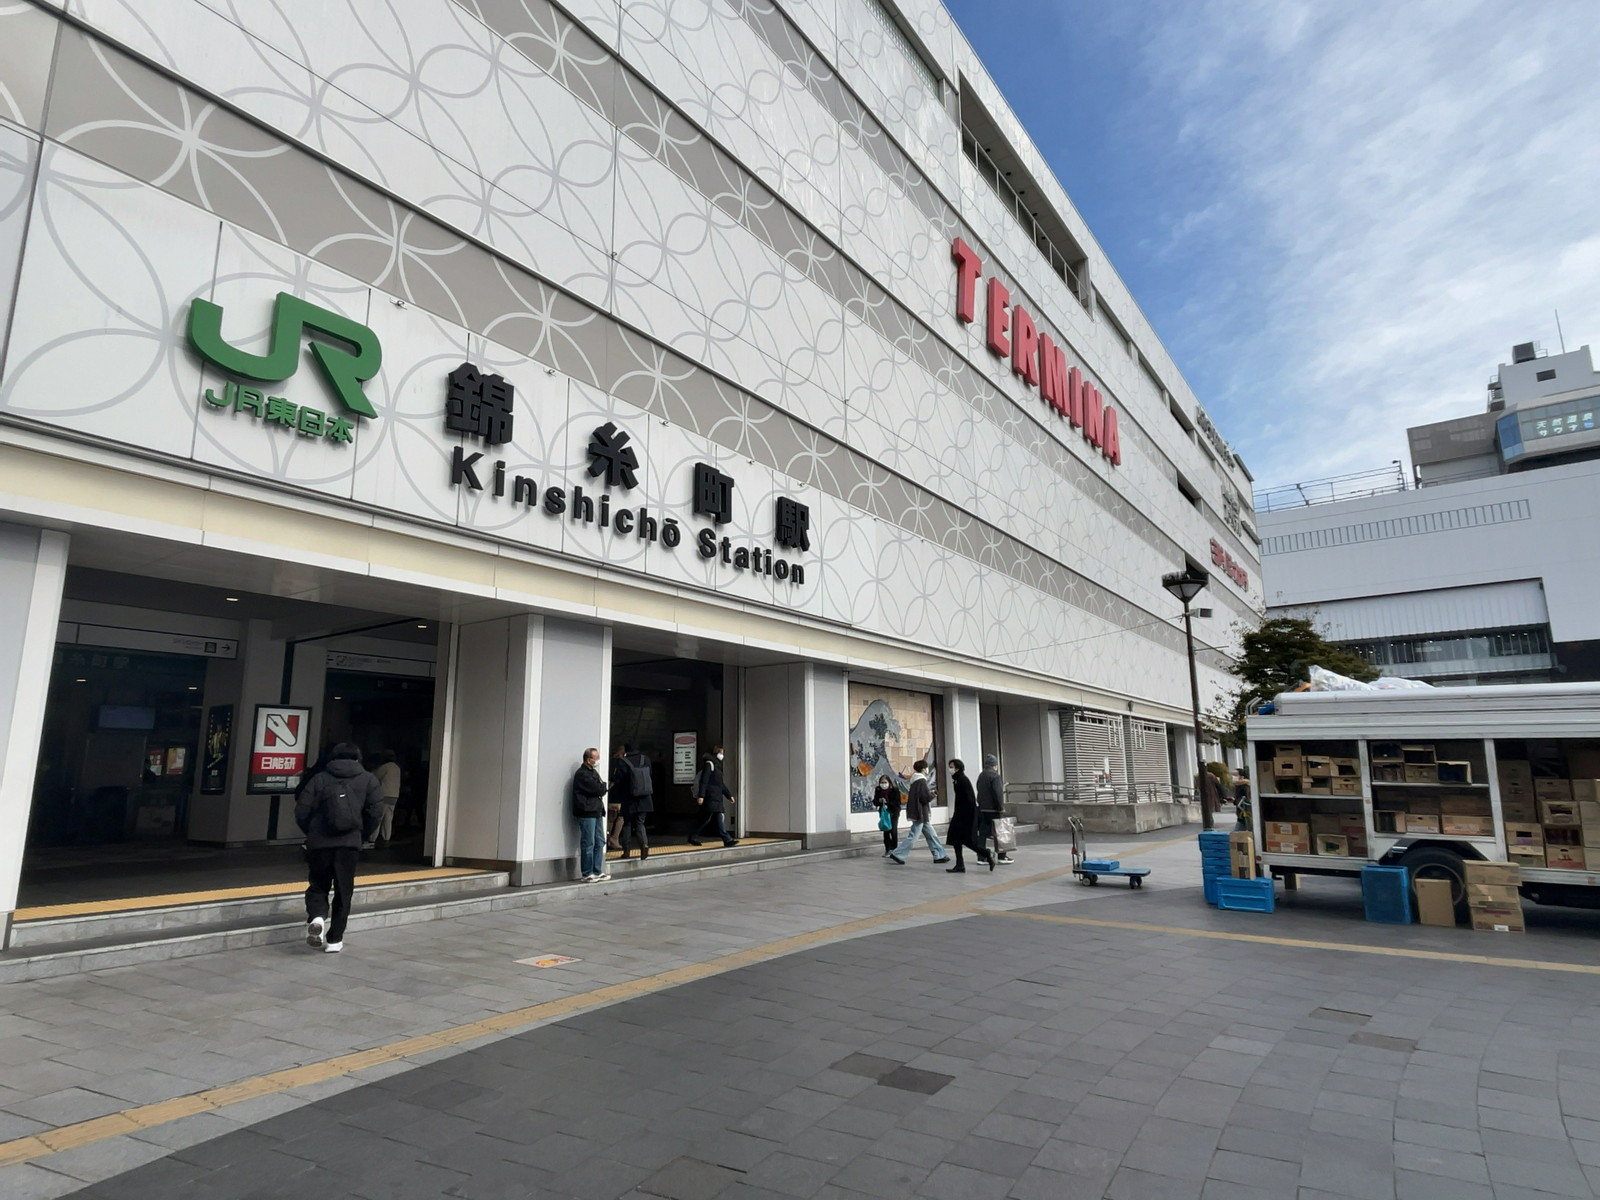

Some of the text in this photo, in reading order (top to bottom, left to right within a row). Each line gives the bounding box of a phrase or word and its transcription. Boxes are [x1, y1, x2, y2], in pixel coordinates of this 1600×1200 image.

[187, 291, 382, 419] JR
[205, 381, 354, 443] JR東日本
[953, 238, 1120, 466] TERMINA
[447, 362, 811, 552] 錦糸町駅
[452, 446, 805, 584] Kinshichō Station
[261, 756, 296, 770] 日能研
